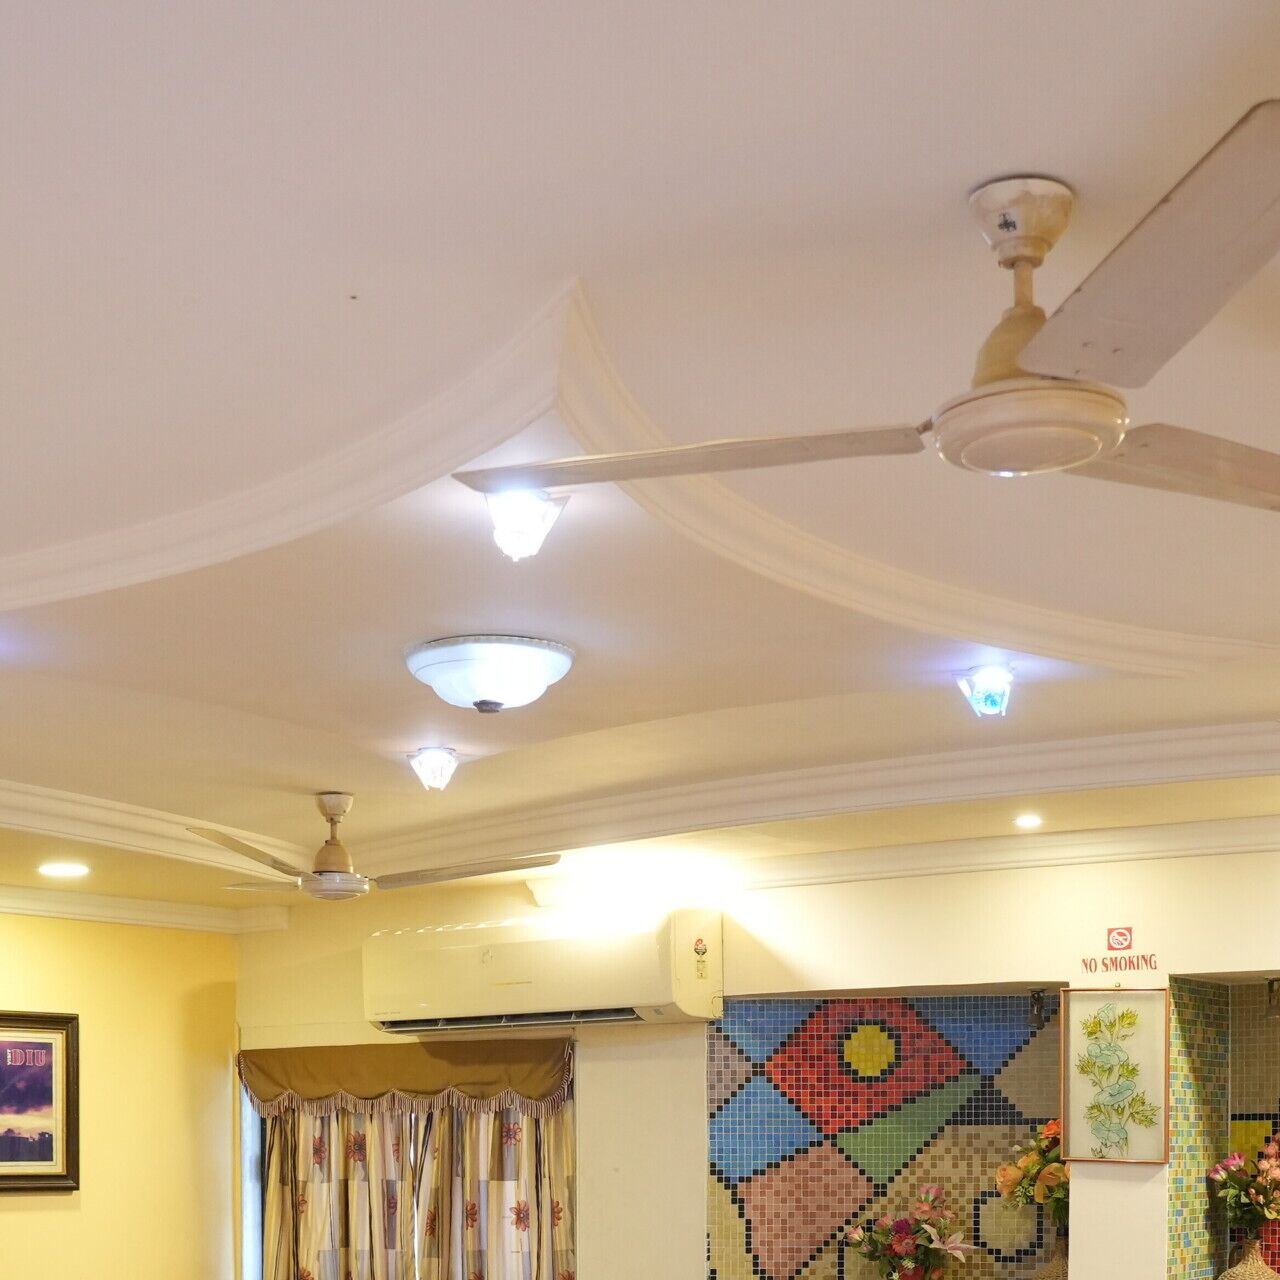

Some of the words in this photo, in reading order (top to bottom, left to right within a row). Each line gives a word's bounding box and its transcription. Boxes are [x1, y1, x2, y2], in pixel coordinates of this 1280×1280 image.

[1081, 957, 1098, 974] NO
[1101, 953, 1158, 972] SMOKING
[11, 1048, 47, 1067] DIU
